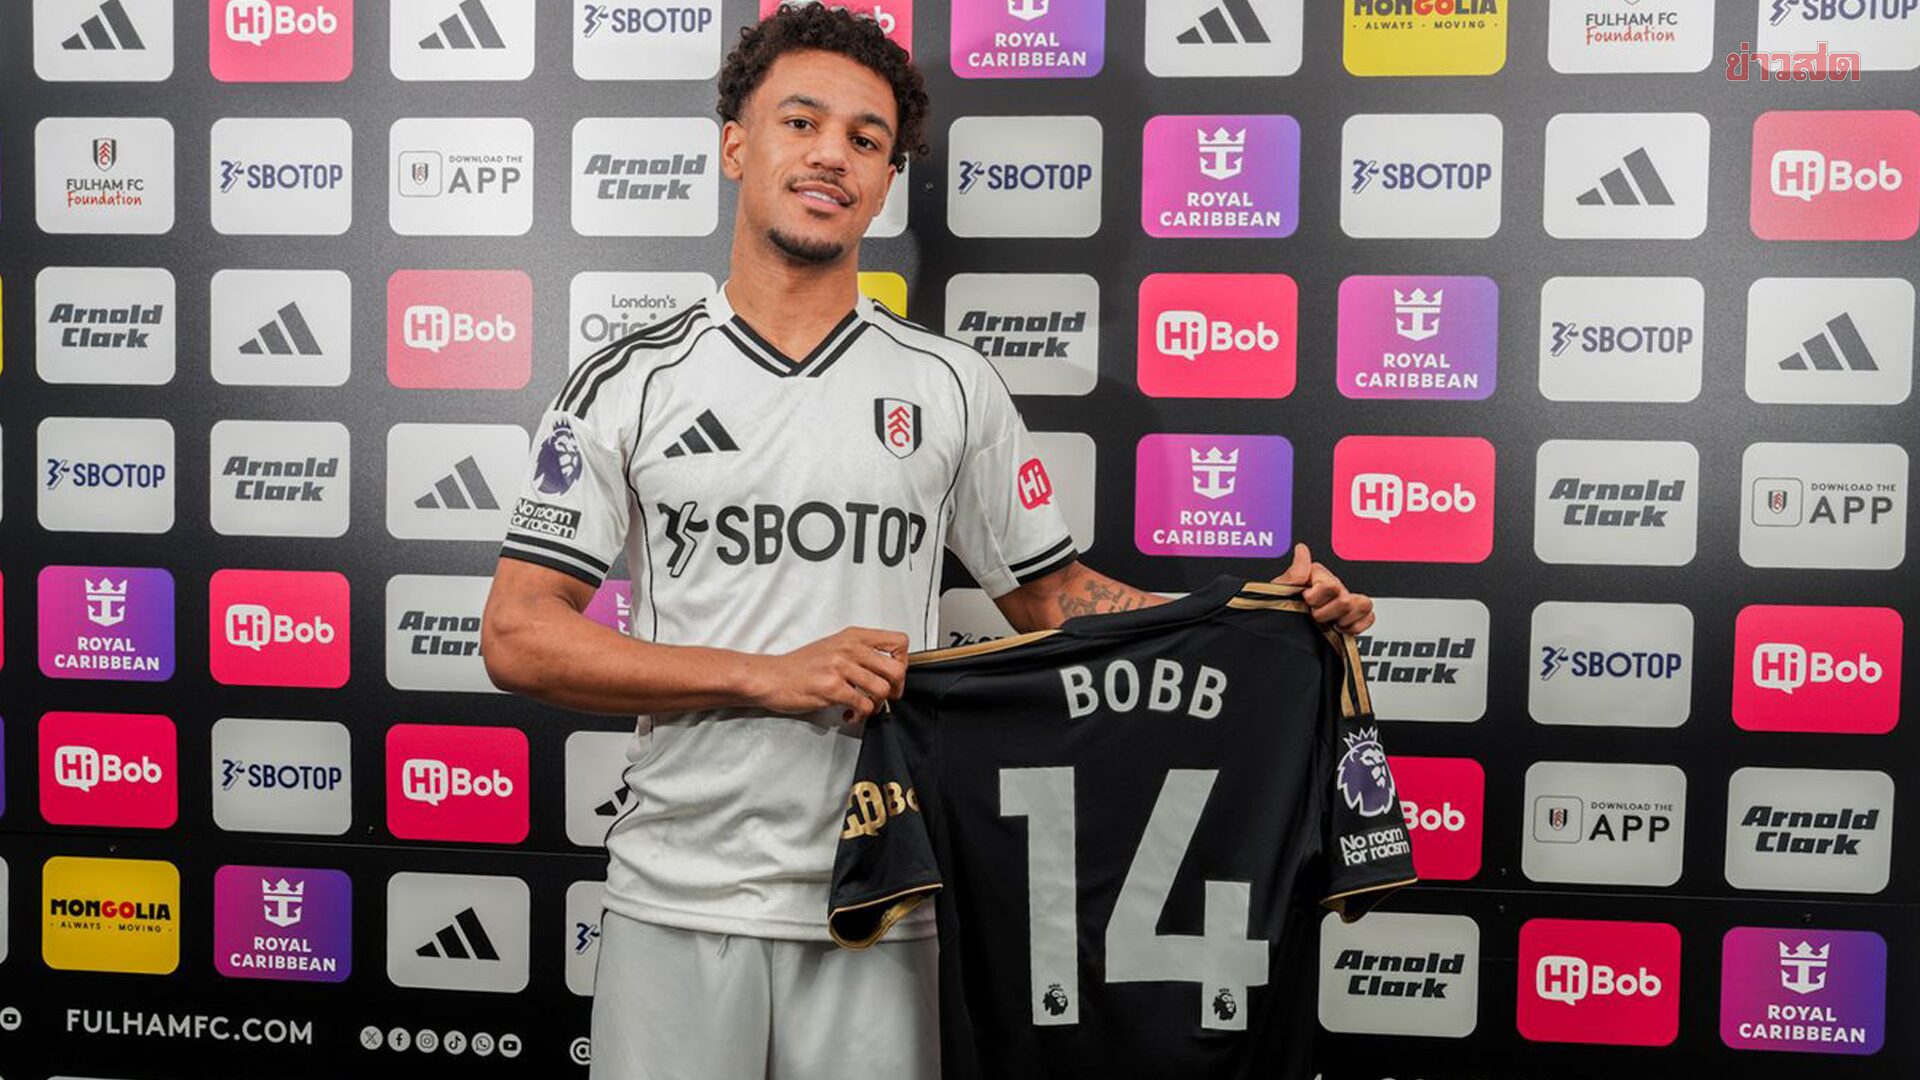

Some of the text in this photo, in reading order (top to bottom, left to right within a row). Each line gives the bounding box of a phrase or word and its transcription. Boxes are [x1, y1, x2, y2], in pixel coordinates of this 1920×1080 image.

[226, 0, 337, 40] HiBob
[612, 8, 712, 33] SBOTOP
[1434, 21, 1485, 29] MOVING
[1586, 13, 1677, 26] FULHAM FC
[996, 32, 1059, 47] ROYAL
[1586, 28, 1674, 46] Foundation
[969, 52, 1086, 67] CARIBBEAN
[584, 154, 707, 175] Arnold
[1771, 151, 1902, 197] HiBob
[67, 179, 143, 191] FULHAM FC
[247, 165, 342, 188] SBOTOP
[448, 167, 520, 193] APP
[988, 165, 1091, 189] SBOTOP
[1382, 164, 1491, 189] SBOTOP
[68, 192, 142, 206] Foundation
[598, 179, 691, 199] Clark
[1188, 192, 1253, 206] ROYAL
[1160, 212, 1280, 226] CARIBBEAN
[612, 295, 676, 308] London's
[49, 304, 163, 324] Arnold
[958, 311, 1086, 332] Arnold
[62, 328, 148, 348] Clark
[404, 306, 516, 348] HiBob
[1156, 311, 1279, 356] HiBob
[972, 335, 1071, 359] Clark
[1582, 327, 1692, 353] SBOTOP
[1384, 353, 1450, 368] ROYAL
[1356, 373, 1477, 388] CARIBBEAN
[73, 463, 165, 488] SBOTOP
[223, 456, 338, 477] Arnold
[235, 480, 323, 501] Clark
[1020, 463, 1048, 505] Hi
[1549, 478, 1685, 501] Arnold
[1812, 483, 1873, 491] DOWNLOAD
[1351, 473, 1476, 521] HiBob
[533, 505, 572, 525] room
[1181, 511, 1245, 526] ROYAL
[1564, 505, 1667, 527] Clark
[1810, 496, 1892, 524] APP
[526, 518, 576, 539] racism
[715, 500, 928, 568] SBOTOP
[1153, 530, 1272, 546] CARIBBEAN
[225, 604, 334, 648] HiBob
[398, 611, 480, 632] Arno
[78, 637, 135, 651] ROYAL
[411, 635, 483, 656] Clar
[1355, 636, 1475, 659] Arnold
[55, 655, 159, 670] CARIBBEAN
[1361, 661, 1459, 684] Clark
[1572, 652, 1681, 678] SBOTOP
[1752, 642, 1882, 691] HiBob
[1060, 658, 1228, 719] BOBB
[55, 746, 162, 789] HiBob
[249, 764, 341, 790] SBOTOP
[402, 759, 514, 802] HiBob
[1400, 800, 1465, 831] Bob
[1591, 802, 1650, 810] DOWNLOAD
[1589, 814, 1669, 842] APP
[1741, 806, 1879, 830] Arnold
[1340, 827, 1404, 851] No room
[1370, 840, 1410, 860] racism
[1756, 832, 1860, 855] Clark
[51, 899, 170, 920] MONGOLIA
[999, 766, 1270, 1031] 14
[119, 924, 161, 932] MOVING
[254, 937, 311, 952] ROYAL
[231, 954, 335, 971] CARIBBEAN
[1334, 950, 1464, 974] Arnold
[1348, 975, 1447, 998] Clark
[1536, 955, 1662, 1003] HiBob
[1768, 1005, 1836, 1021] ROYAL
[67, 1009, 312, 1044] FULHAMFC.COM
[1739, 1023, 1865, 1042] CARIBBEAN
